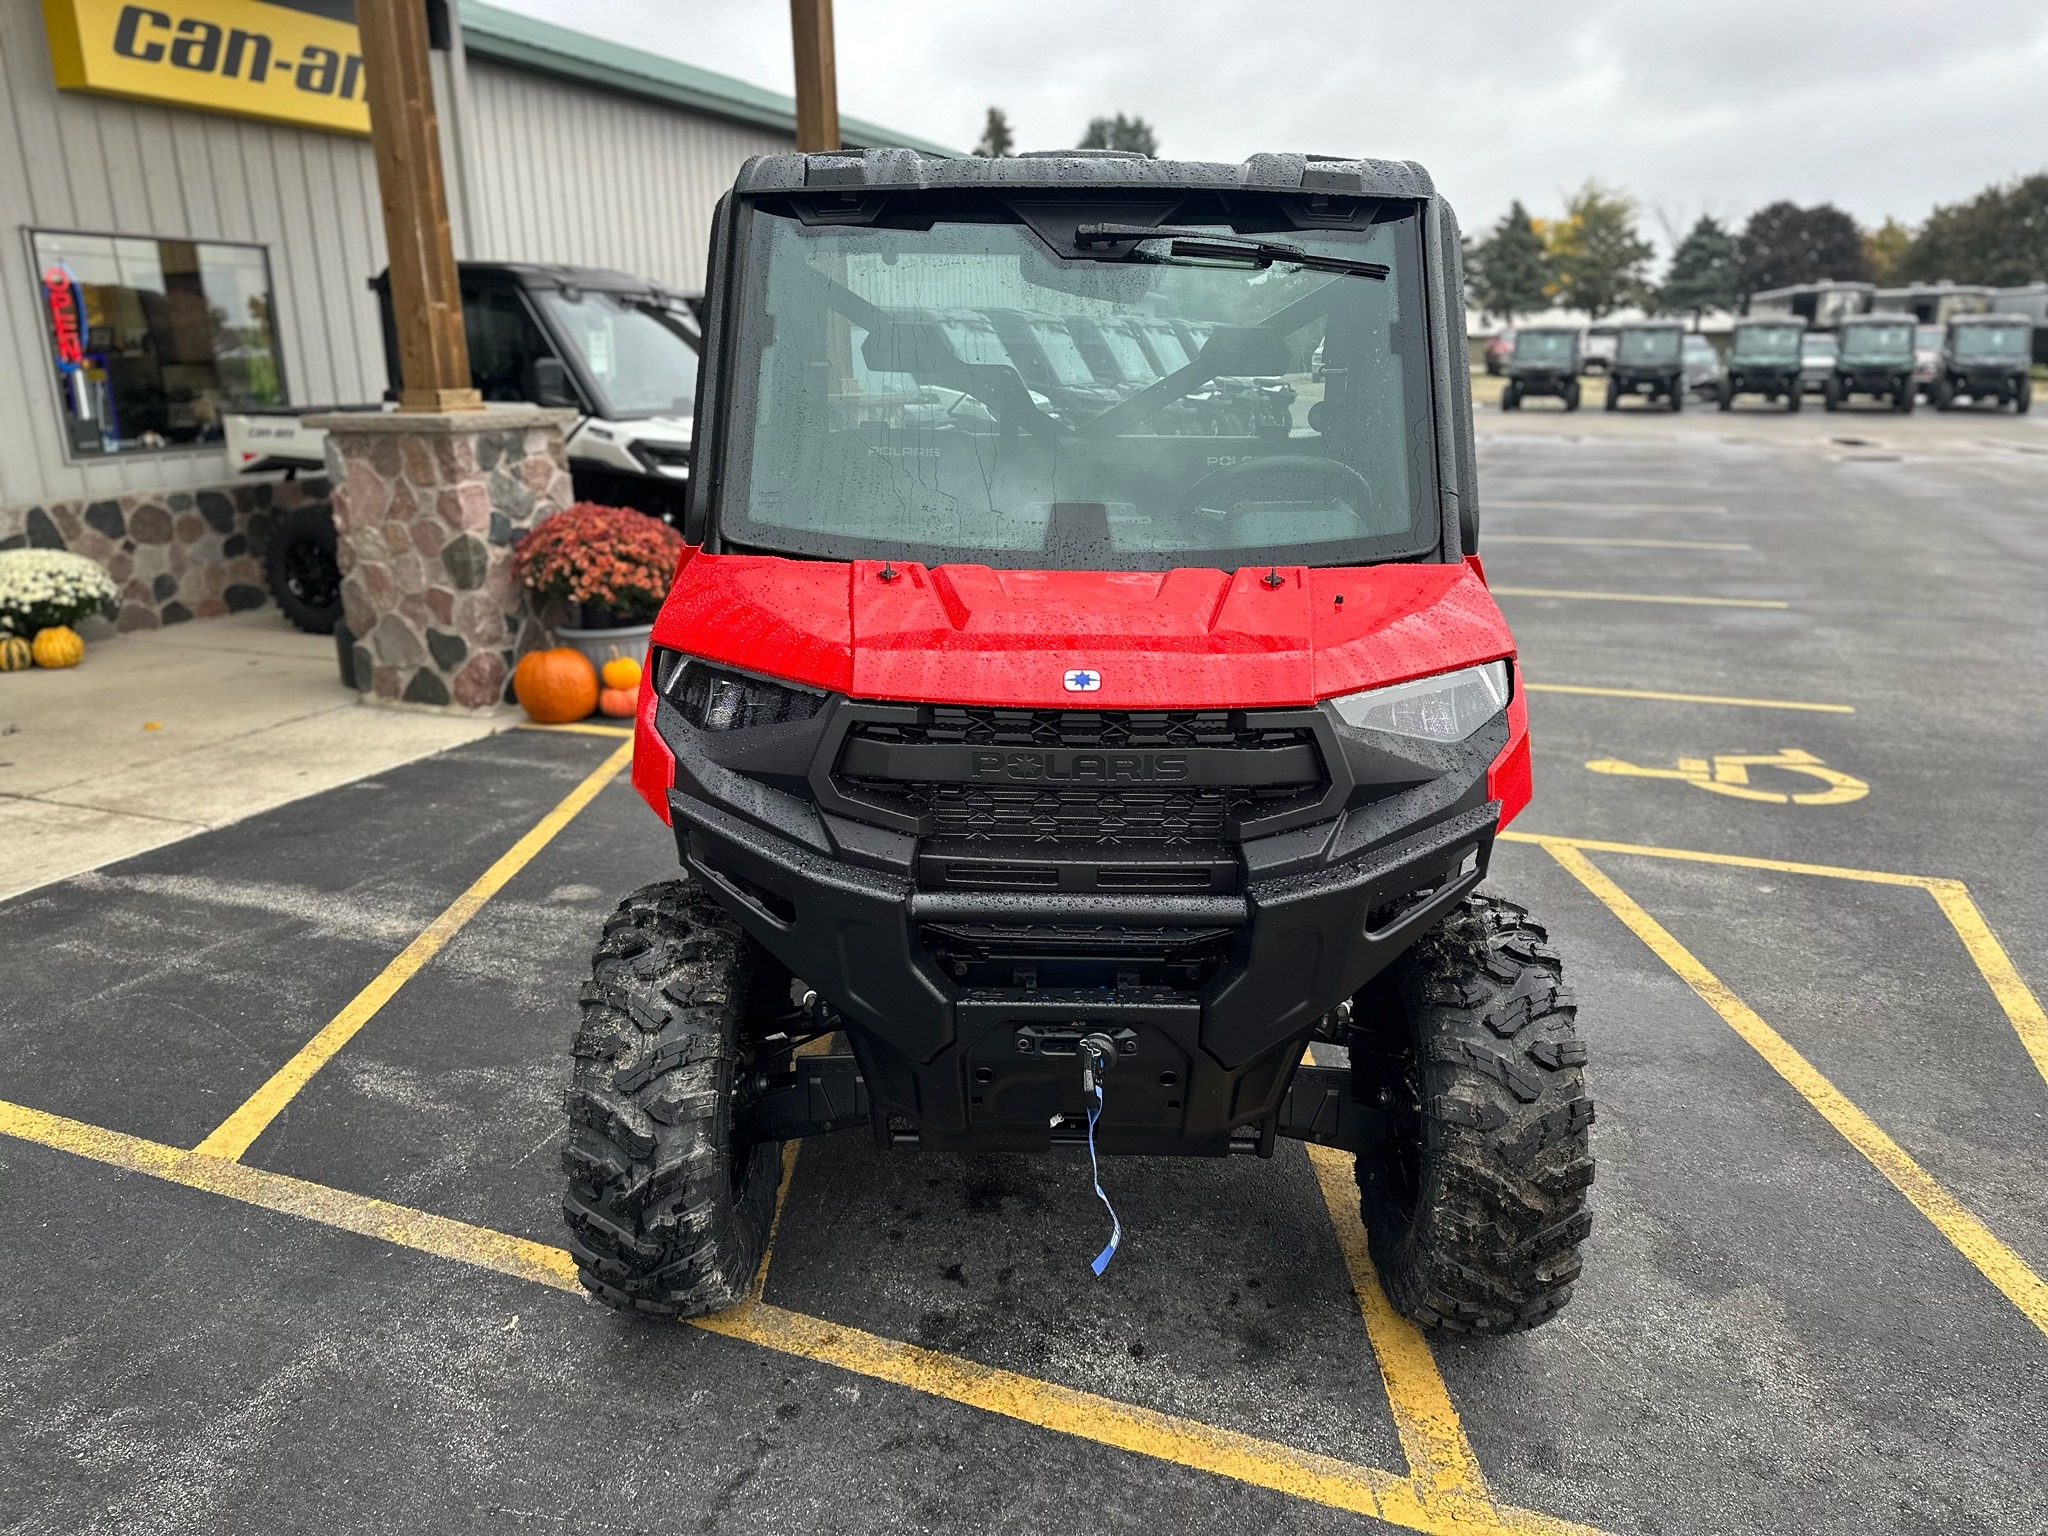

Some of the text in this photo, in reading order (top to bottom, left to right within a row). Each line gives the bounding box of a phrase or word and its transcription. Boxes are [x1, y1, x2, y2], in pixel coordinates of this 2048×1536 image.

[45, 266, 82, 362] OPEN
[867, 446, 940, 457] POLARIS
[971, 751, 1189, 782] POLARIS
